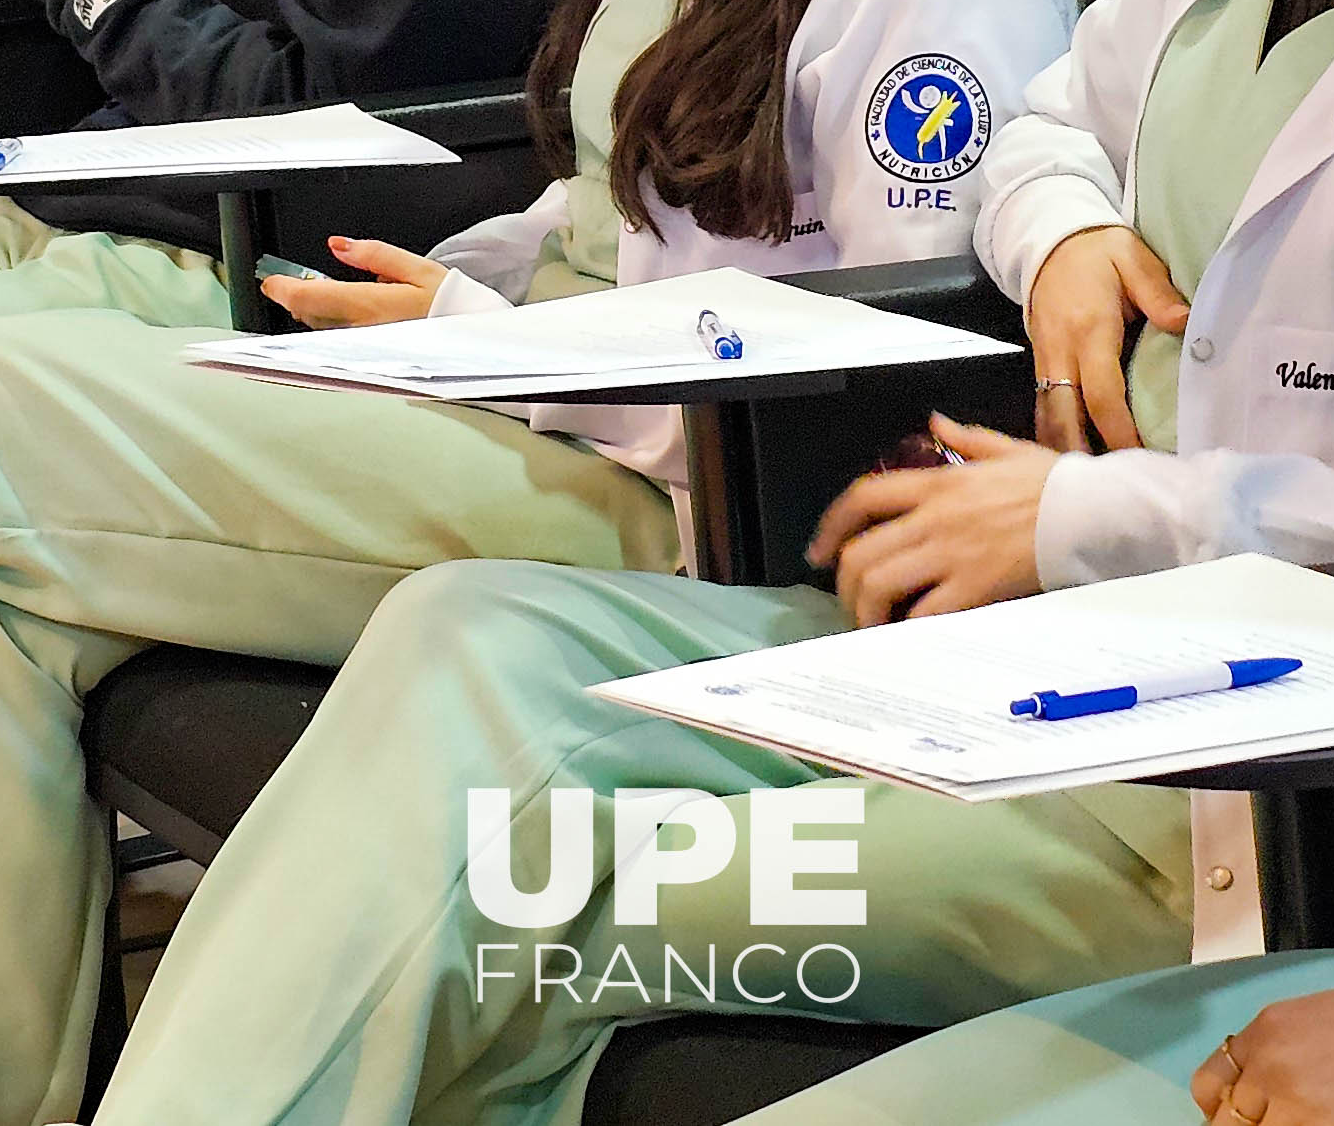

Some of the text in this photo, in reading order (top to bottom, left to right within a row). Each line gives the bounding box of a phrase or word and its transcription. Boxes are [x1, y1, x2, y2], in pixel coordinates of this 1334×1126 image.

[870, 58, 990, 135] FACULTAD DE CIENCIAS DE LA SALUD
[878, 148, 974, 179] NUTRICIÓN
[887, 187, 957, 212] U.P.E.
